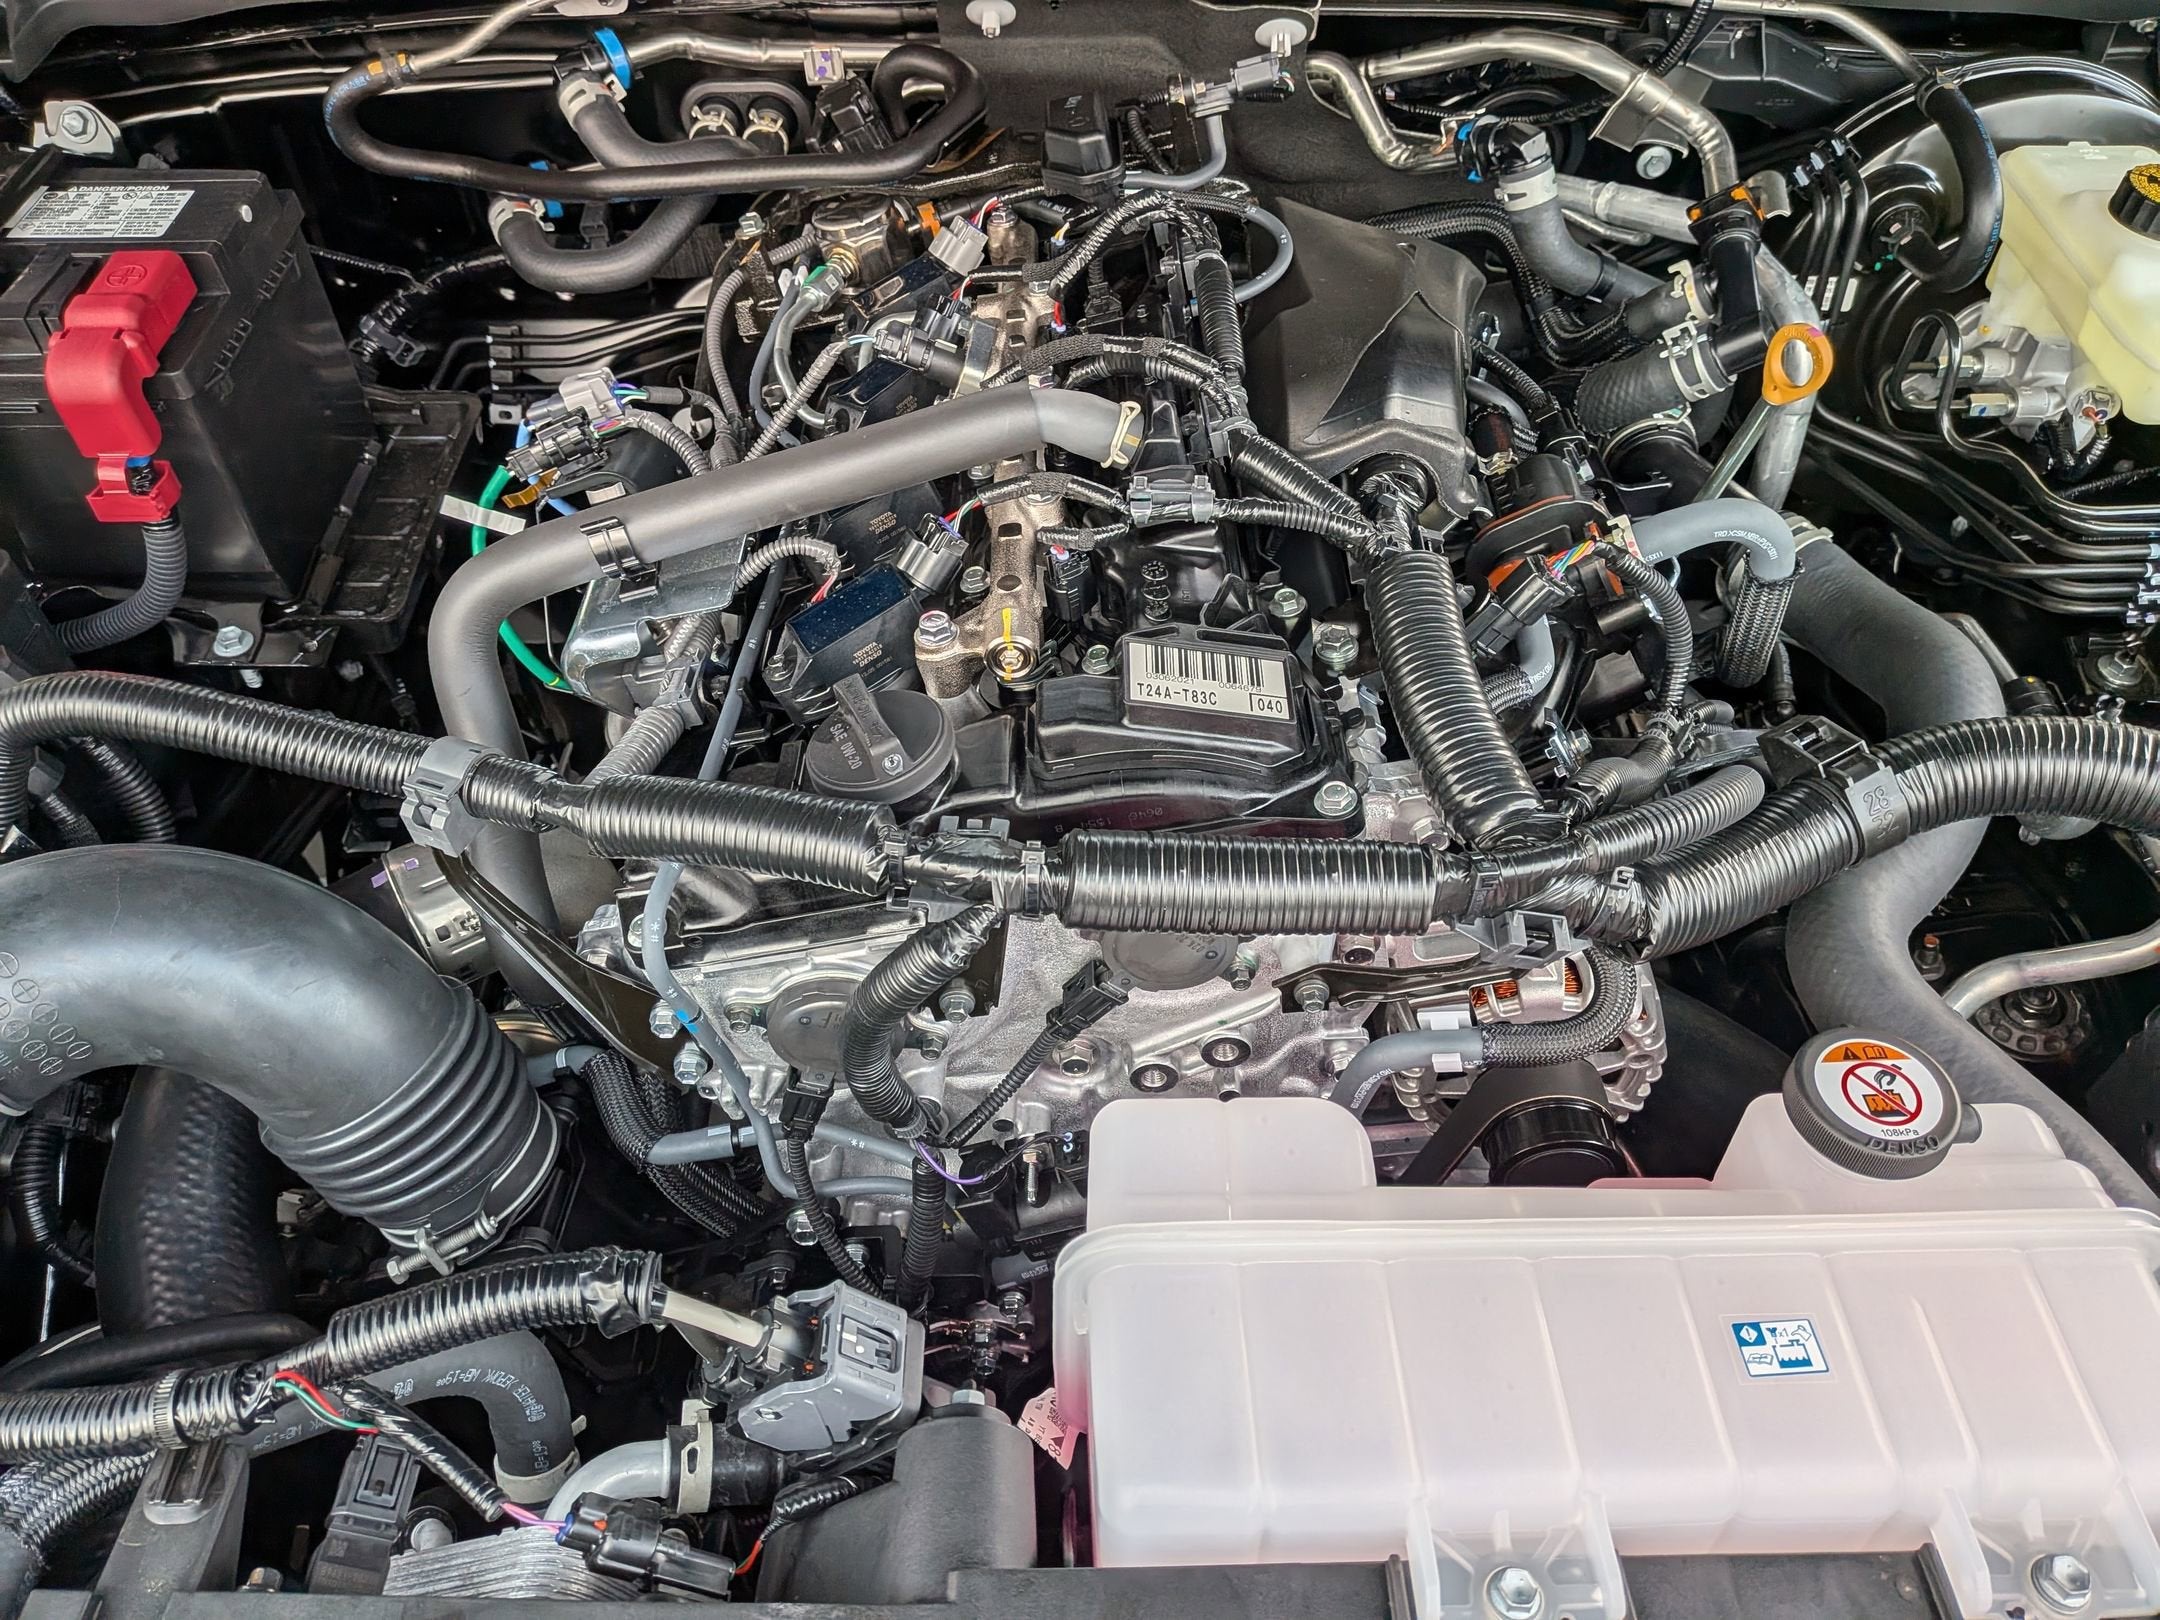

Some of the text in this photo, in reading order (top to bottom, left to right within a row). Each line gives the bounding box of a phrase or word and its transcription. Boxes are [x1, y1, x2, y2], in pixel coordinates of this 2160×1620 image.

[870, 511, 893, 526] TOYOTA
[853, 641, 878, 658] TOYOTA
[859, 649, 882, 667] DENSO
[1145, 672, 1262, 693] 03062021 0064679
[1137, 682, 1283, 714] T24A-T83C 040
[829, 723, 848, 742] SAE
[1862, 785, 1889, 817] 28
[1880, 1128, 1920, 1138] 108kPa
[1866, 1134, 1940, 1156] DENSO
